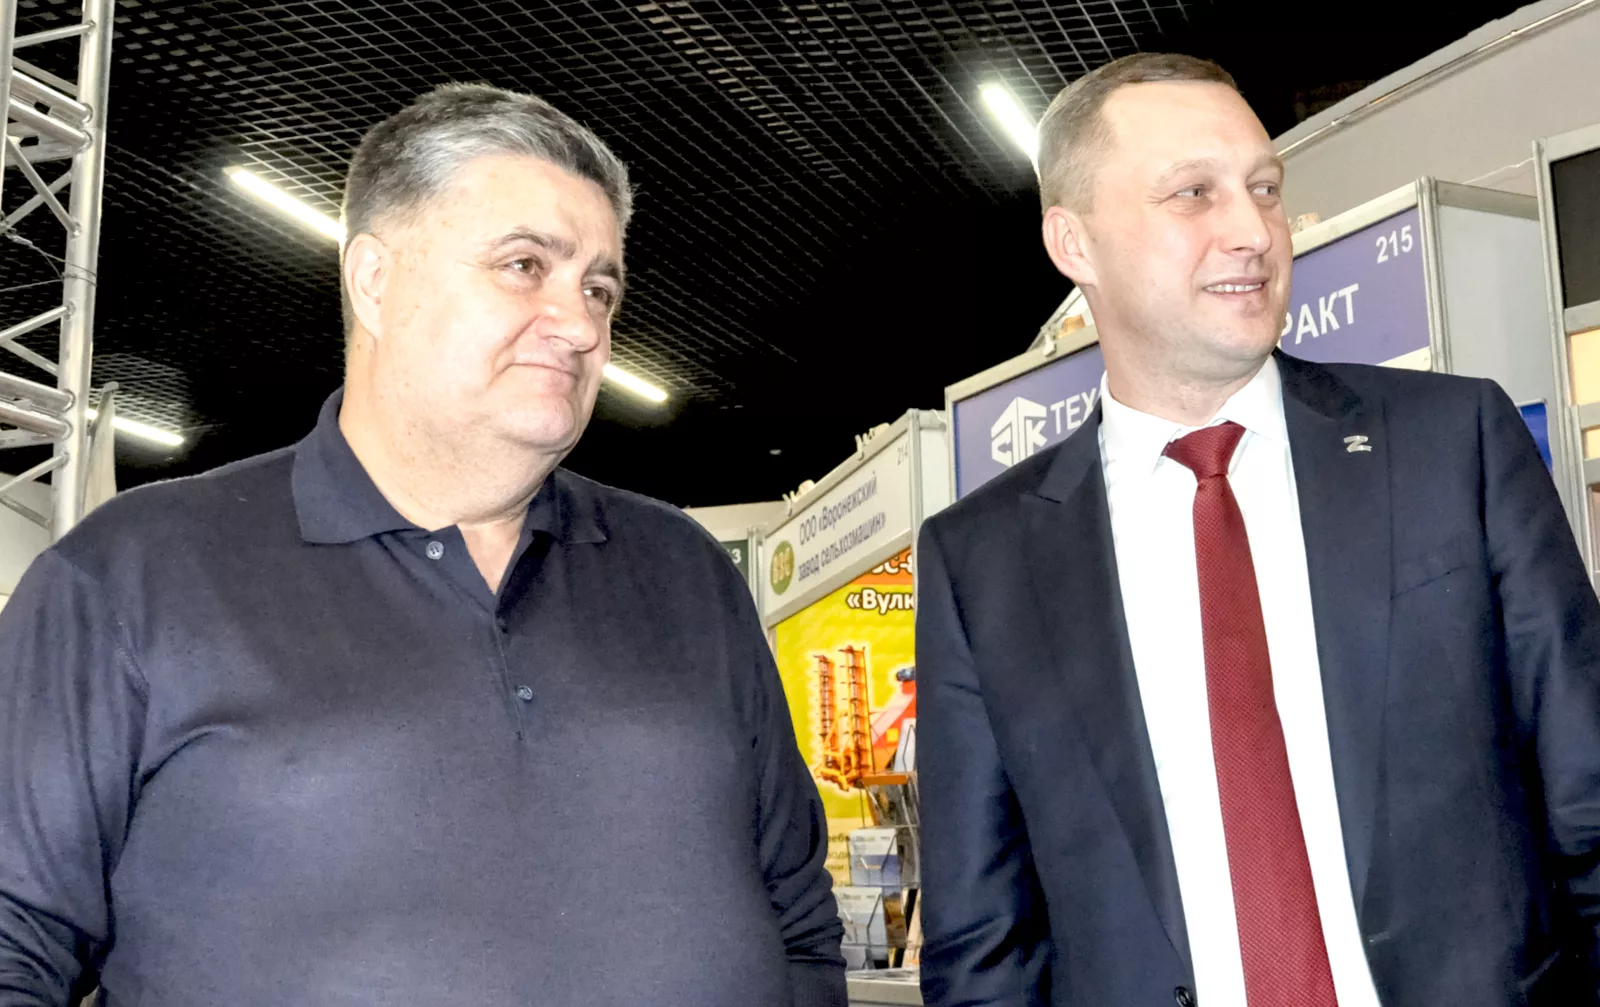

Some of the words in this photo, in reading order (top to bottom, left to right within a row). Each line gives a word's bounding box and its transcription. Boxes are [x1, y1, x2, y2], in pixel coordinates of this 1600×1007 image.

[1376, 224, 1413, 264] 215
[799, 514, 817, 546] ООО
[819, 470, 877, 532] «Воронежский
[799, 554, 820, 582] завод
[820, 511, 886, 568] сельхозмашин»
